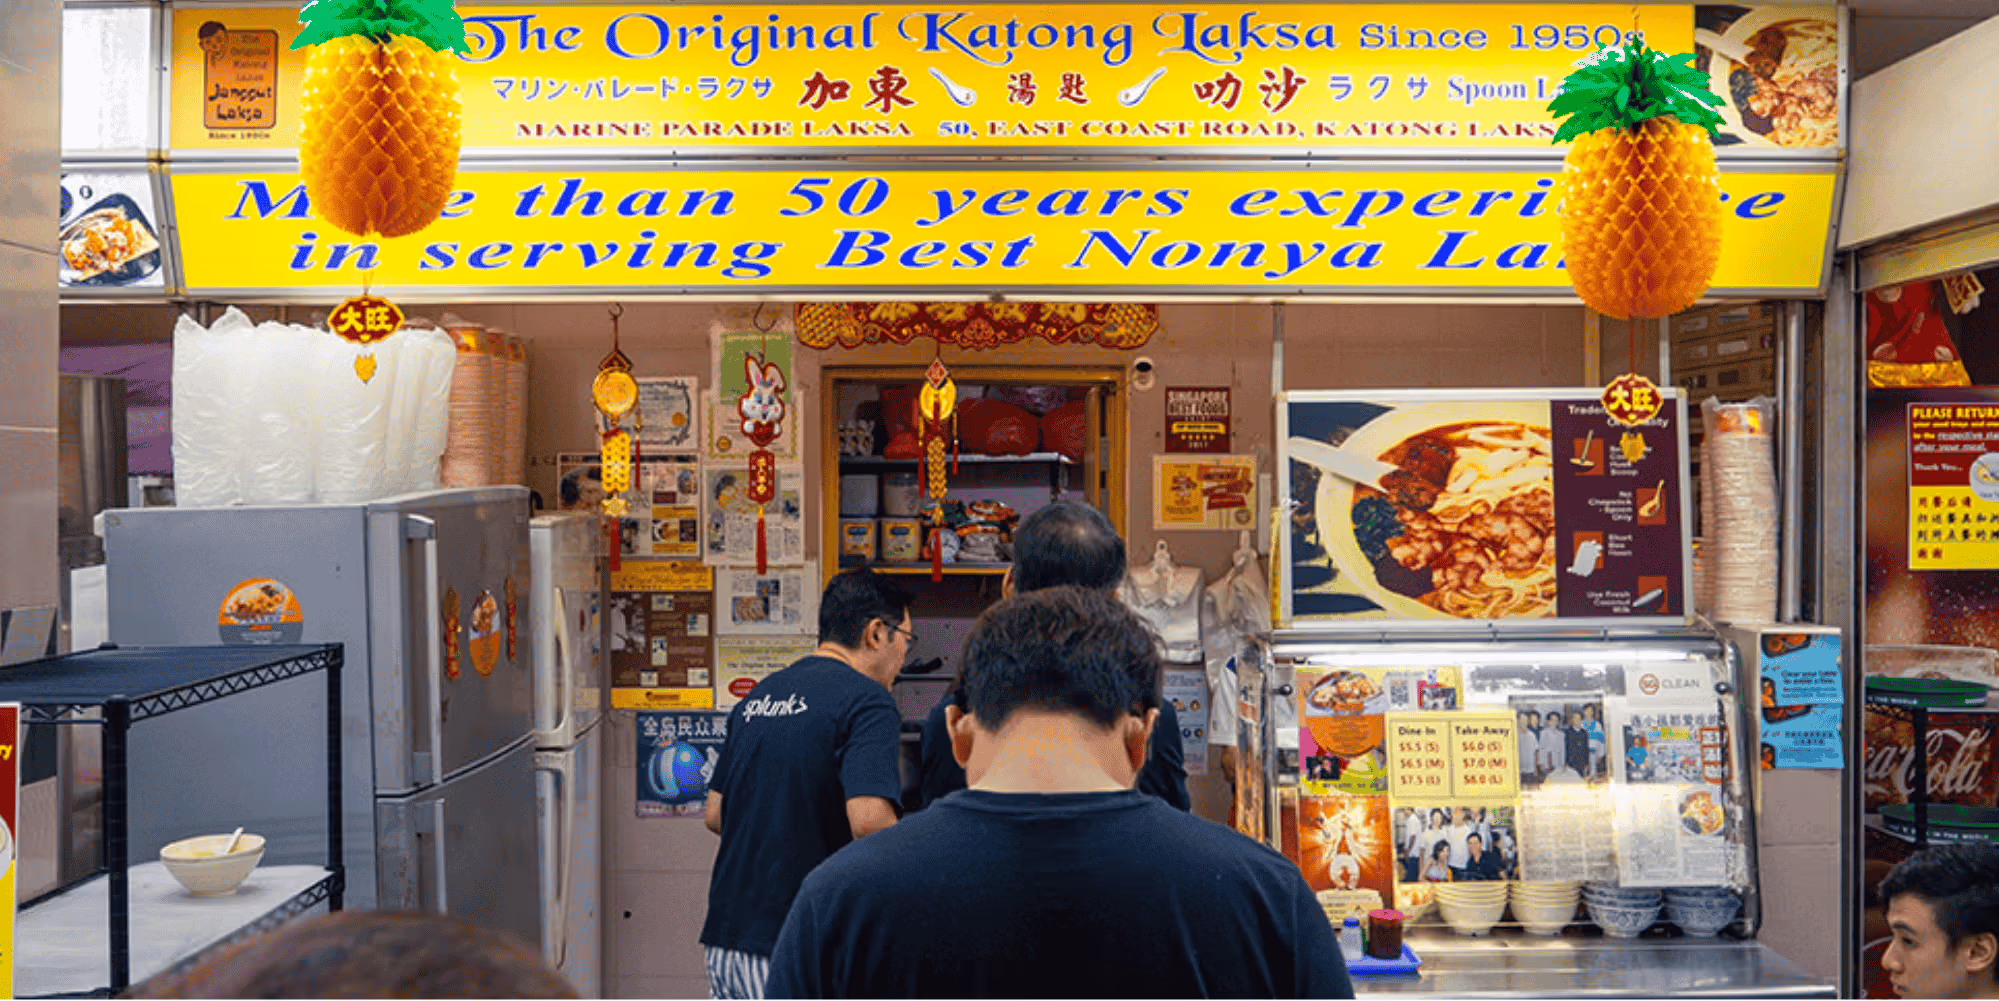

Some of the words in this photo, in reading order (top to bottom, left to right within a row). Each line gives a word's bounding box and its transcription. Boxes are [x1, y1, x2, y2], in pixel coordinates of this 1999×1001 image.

[457, 13, 582, 62] The
[606, 12, 878, 66] Original
[899, 12, 1132, 66] Katong
[1153, 12, 1338, 65] Laksa
[1360, 24, 1488, 50] Since
[1510, 24, 1645, 50] 1950s
[208, 83, 272, 102] Janggut
[799, 66, 916, 114] 加東
[1007, 73, 1090, 106] 湯匙
[1194, 67, 1306, 113] 叻沙
[1328, 76, 1429, 100] ラクサ
[1447, 78, 1527, 105] Spoon
[217, 104, 263, 122] Laksa
[516, 121, 651, 137] MARINE
[662, 121, 793, 137] PARADE
[801, 121, 912, 137] LAKSA
[938, 121, 977, 138] 50,
[988, 121, 1075, 137] EAST
[1081, 121, 1196, 137] COAST
[1202, 121, 1304, 138] ROAD,
[1314, 121, 1458, 137] KATONG
[1467, 121, 1555, 137] LAKS
[224, 178, 475, 219] Me
[514, 178, 735, 219] than
[779, 176, 889, 216] 50
[915, 188, 1190, 226] years
[1228, 176, 1786, 228] experie
[288, 231, 380, 270] in
[419, 230, 785, 280] serving
[815, 230, 1035, 269] Best
[1063, 230, 1383, 280] Nonya
[337, 305, 393, 332] 大旺
[1609, 384, 1655, 412] 大旺
[1913, 407, 1953, 419] PLEASE
[1923, 432, 1936, 440] the
[1914, 462, 1939, 471] Thank
[1661, 679, 1701, 690] CLEAN
[1399, 742, 1422, 753] $5.5
[1425, 741, 1440, 753] (S)
[1487, 741, 1502, 753] (S)
[1400, 758, 1423, 769] $6.5
[1425, 758, 1445, 769] (M)
[1463, 758, 1486, 769] $7.0
[1487, 757, 1508, 769] (M)
[1400, 774, 1423, 785] $7.5
[1425, 774, 1441, 785] (L)
[1488, 774, 1504, 785] (L)
